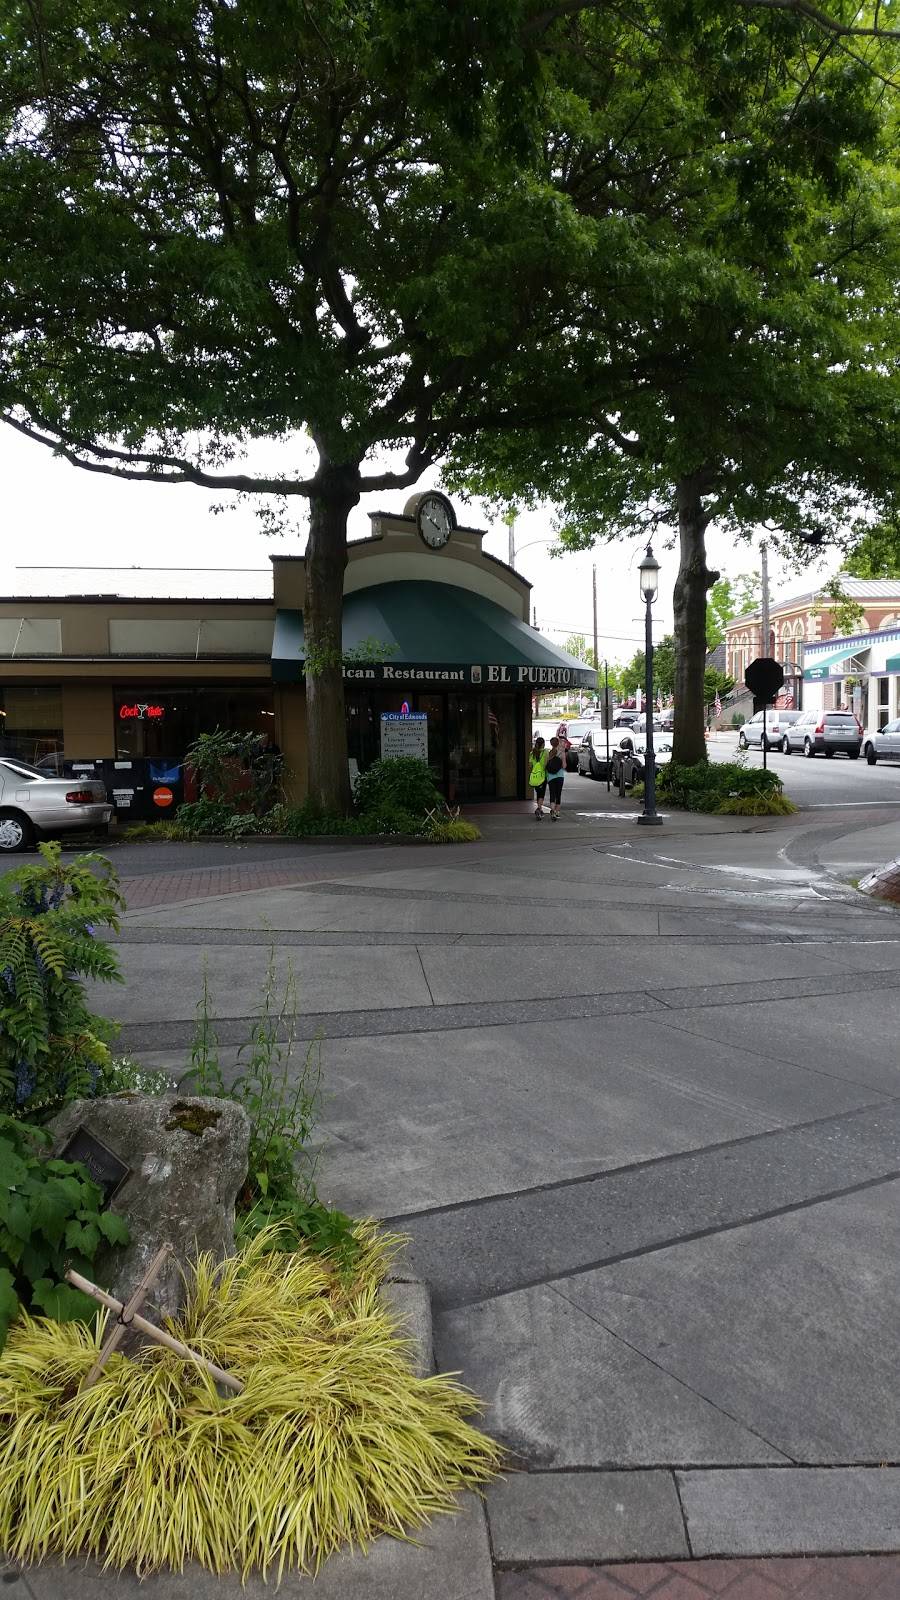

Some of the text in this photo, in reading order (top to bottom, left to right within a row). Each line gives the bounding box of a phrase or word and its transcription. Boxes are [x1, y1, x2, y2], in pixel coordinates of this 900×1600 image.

[383, 666, 465, 680] Restaurant
[487, 665, 511, 682] EL
[517, 666, 570, 684] PUERTO
[119, 704, 139, 719] Cock
